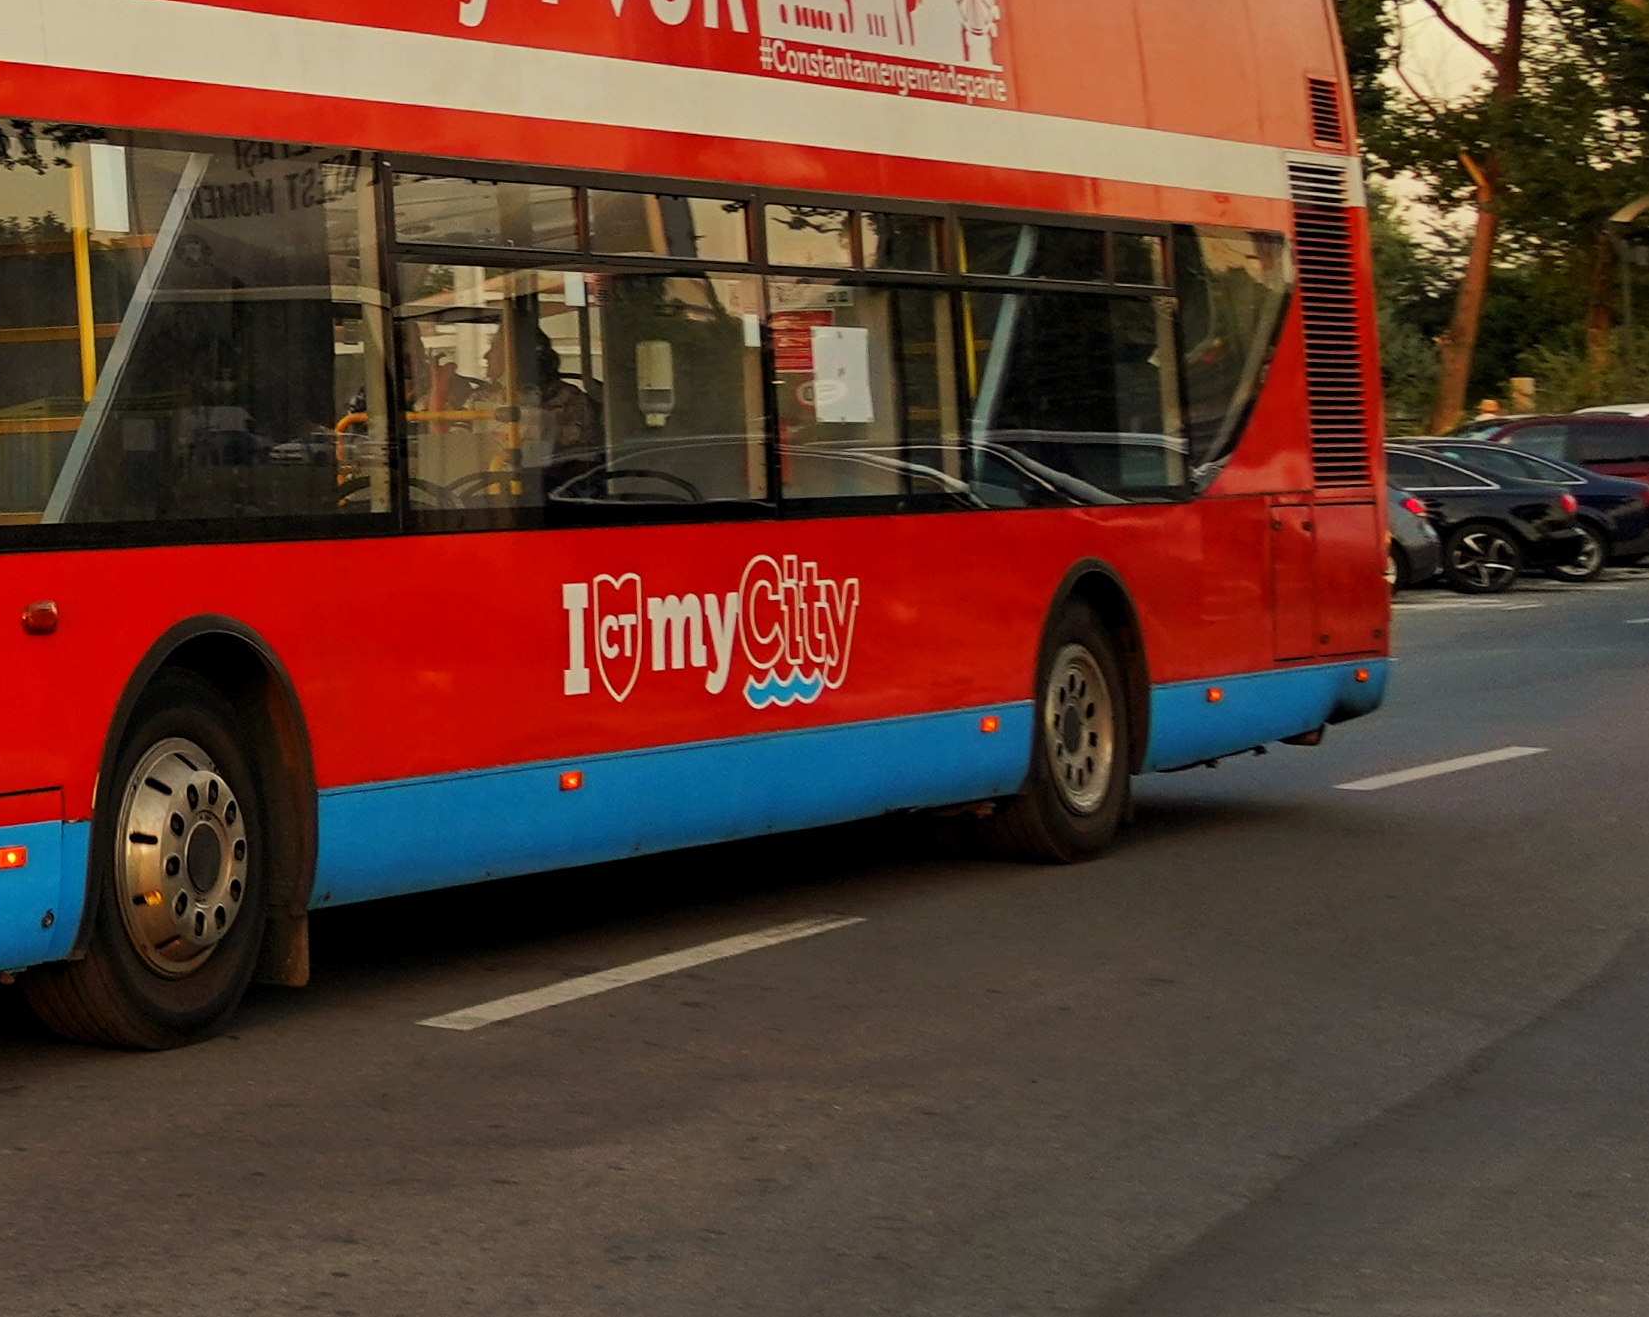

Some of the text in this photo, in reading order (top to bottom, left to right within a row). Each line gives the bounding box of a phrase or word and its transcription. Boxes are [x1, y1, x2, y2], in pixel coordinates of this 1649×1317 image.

[759, 38, 1007, 105] #Constantamergemaideparte
[562, 583, 590, 695] I
[601, 614, 637, 659] CT
